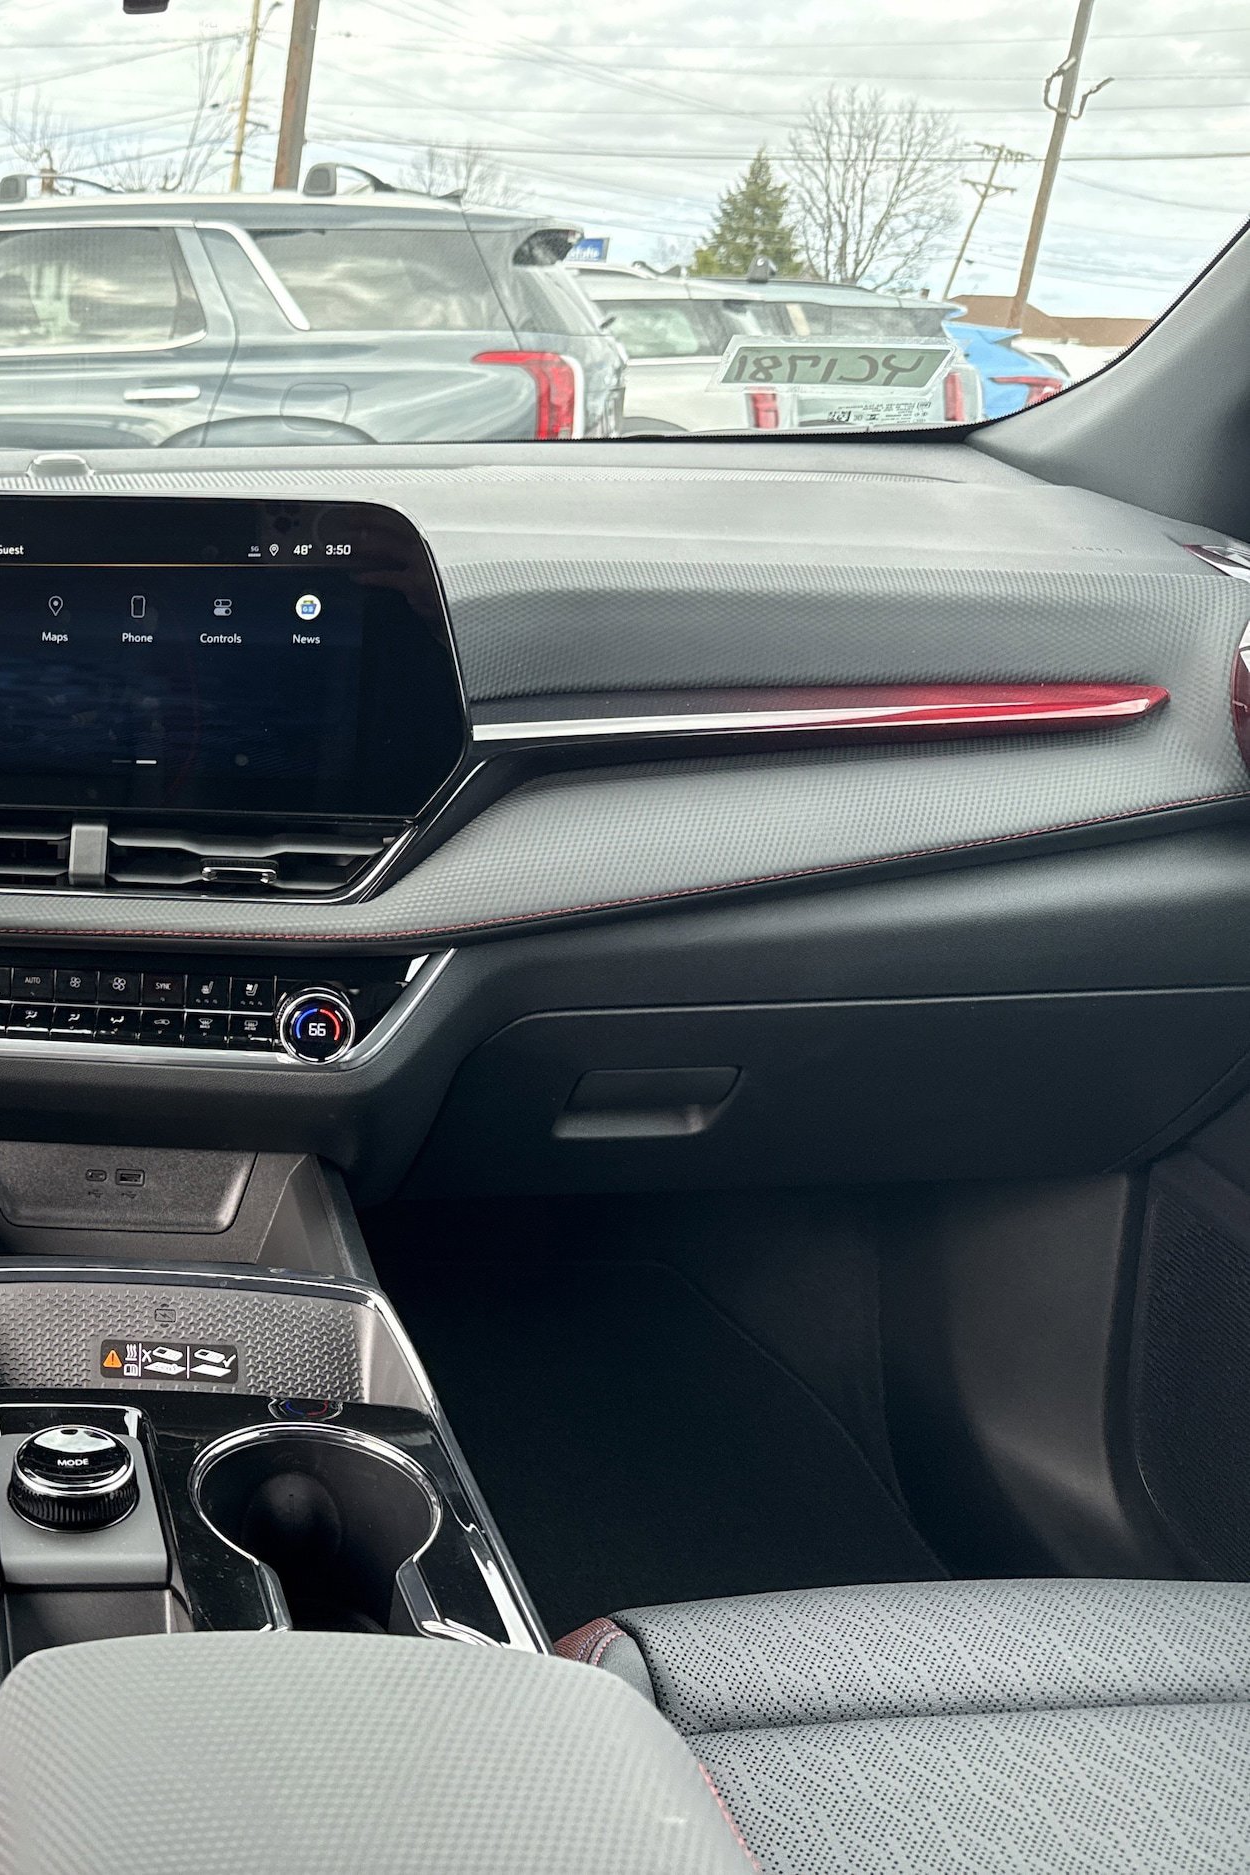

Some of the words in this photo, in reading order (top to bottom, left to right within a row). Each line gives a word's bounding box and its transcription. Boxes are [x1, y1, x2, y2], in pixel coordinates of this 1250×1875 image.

[293, 544, 313, 556] 48°
[325, 544, 352, 556] 3:50
[41, 631, 69, 644] Maps
[121, 632, 154, 644] Phone
[199, 633, 242, 644] Controls
[292, 633, 321, 645] News
[24, 976, 42, 985] AUTO
[308, 1022, 327, 1036] 66
[57, 1458, 90, 1466] MODE
